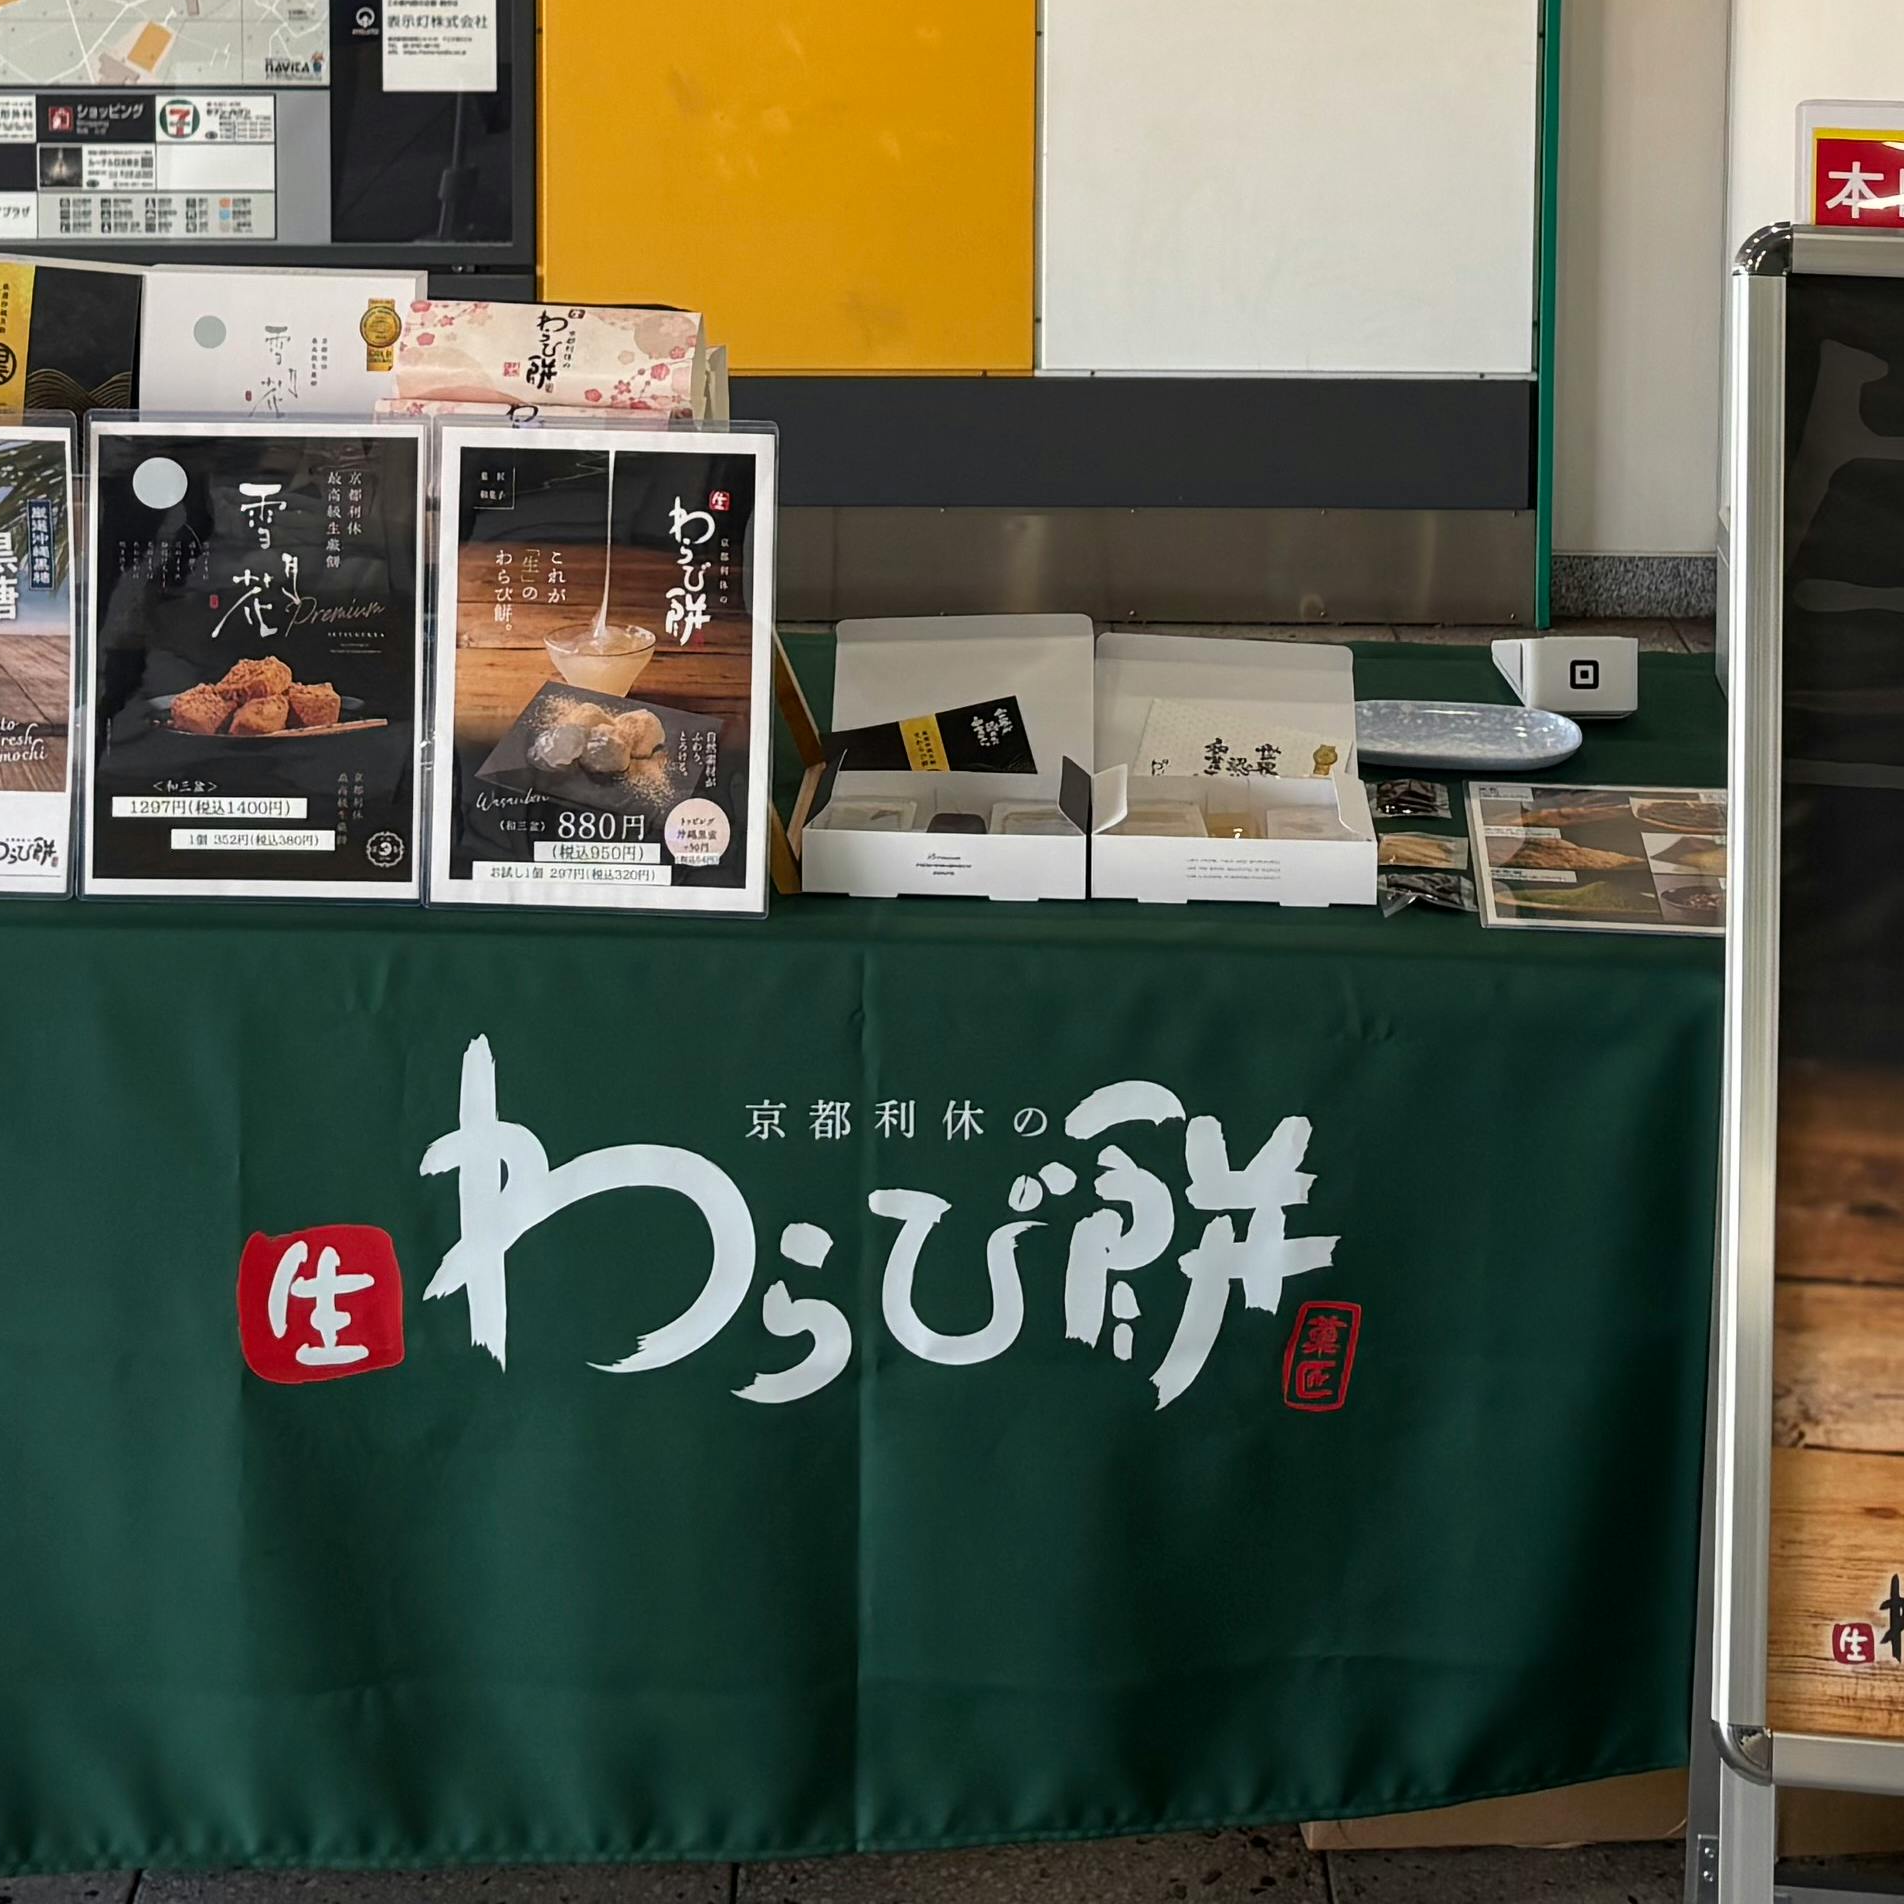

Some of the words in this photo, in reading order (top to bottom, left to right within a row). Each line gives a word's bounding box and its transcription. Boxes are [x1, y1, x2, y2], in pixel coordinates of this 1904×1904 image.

[548, 551, 566, 604] これが
[130, 799, 291, 817] 1297円(税込1400円)
[558, 812, 645, 841] 880円
[745, 1097, 1048, 1139] 京都利休の
[420, 1034, 1341, 1411] わらび餅
[268, 1240, 369, 1364] 生
